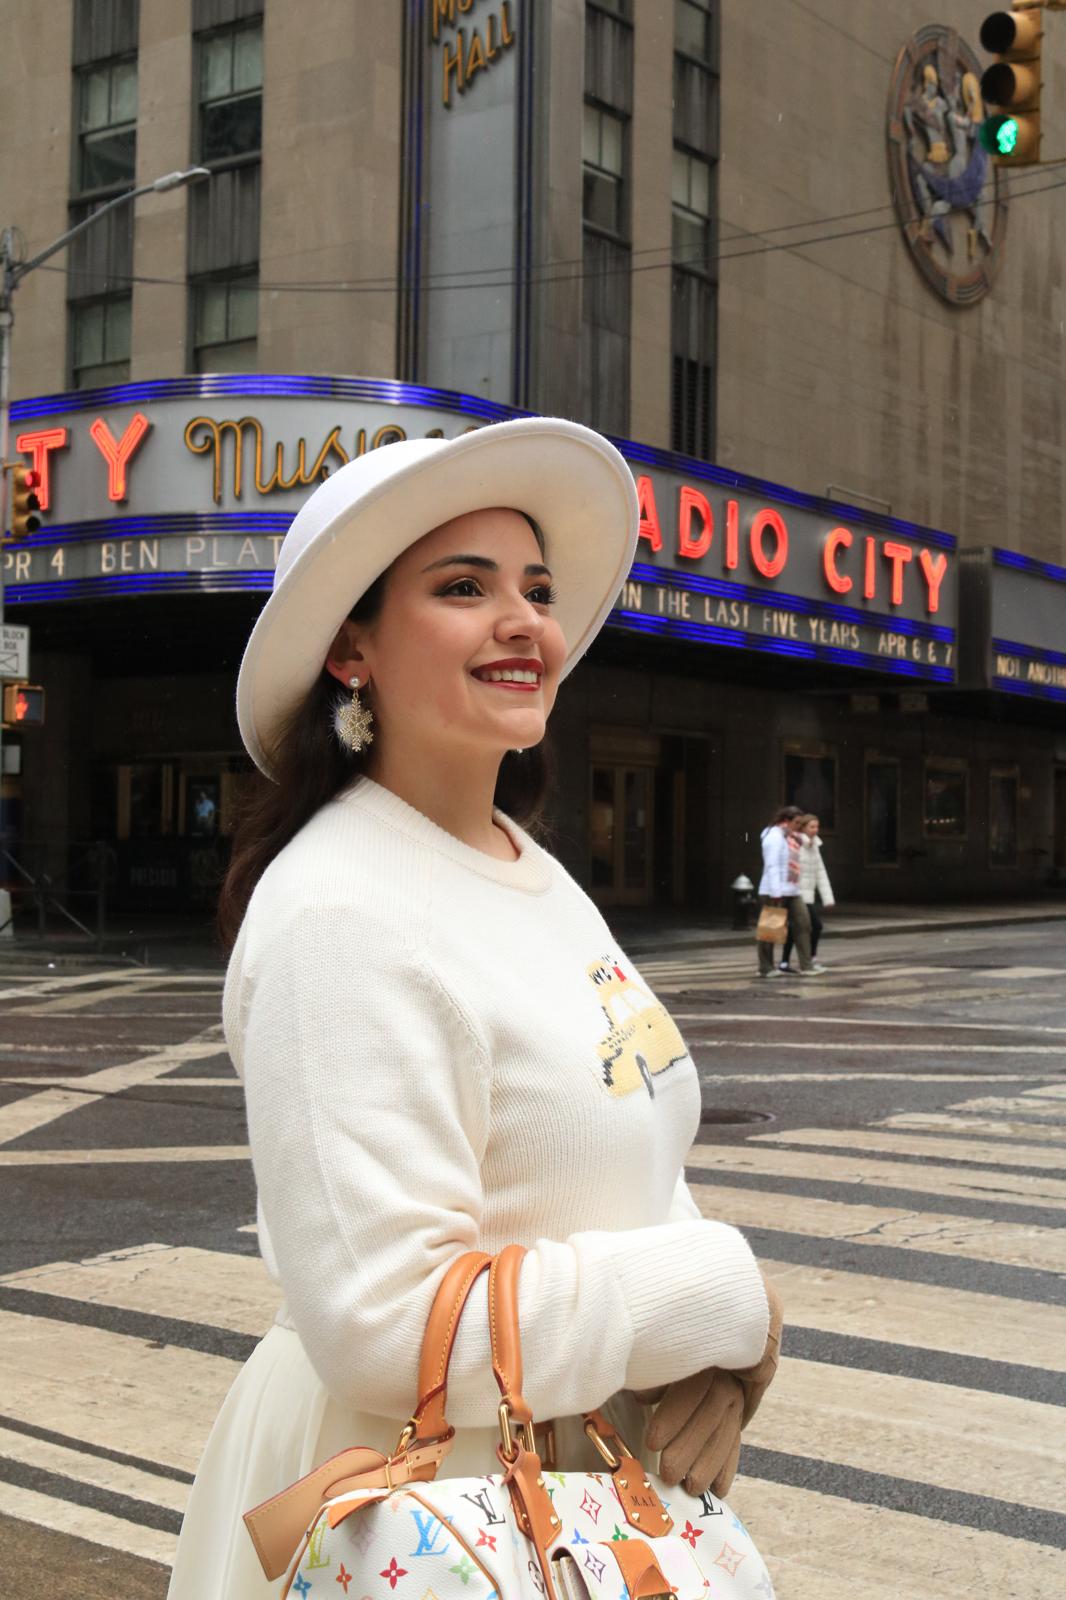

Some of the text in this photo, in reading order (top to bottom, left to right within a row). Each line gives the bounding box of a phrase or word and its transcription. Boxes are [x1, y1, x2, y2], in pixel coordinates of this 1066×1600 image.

[443, 3, 513, 104] HALL
[51, 547, 65, 576] 4
[101, 539, 159, 573] BEN
[824, 527, 948, 613] CITY
[657, 587, 691, 619] THE
[704, 596, 749, 628] LAST
[763, 609, 798, 639] FIVE
[808, 617, 860, 650] YEARS
[878, 632, 907, 657] APR
